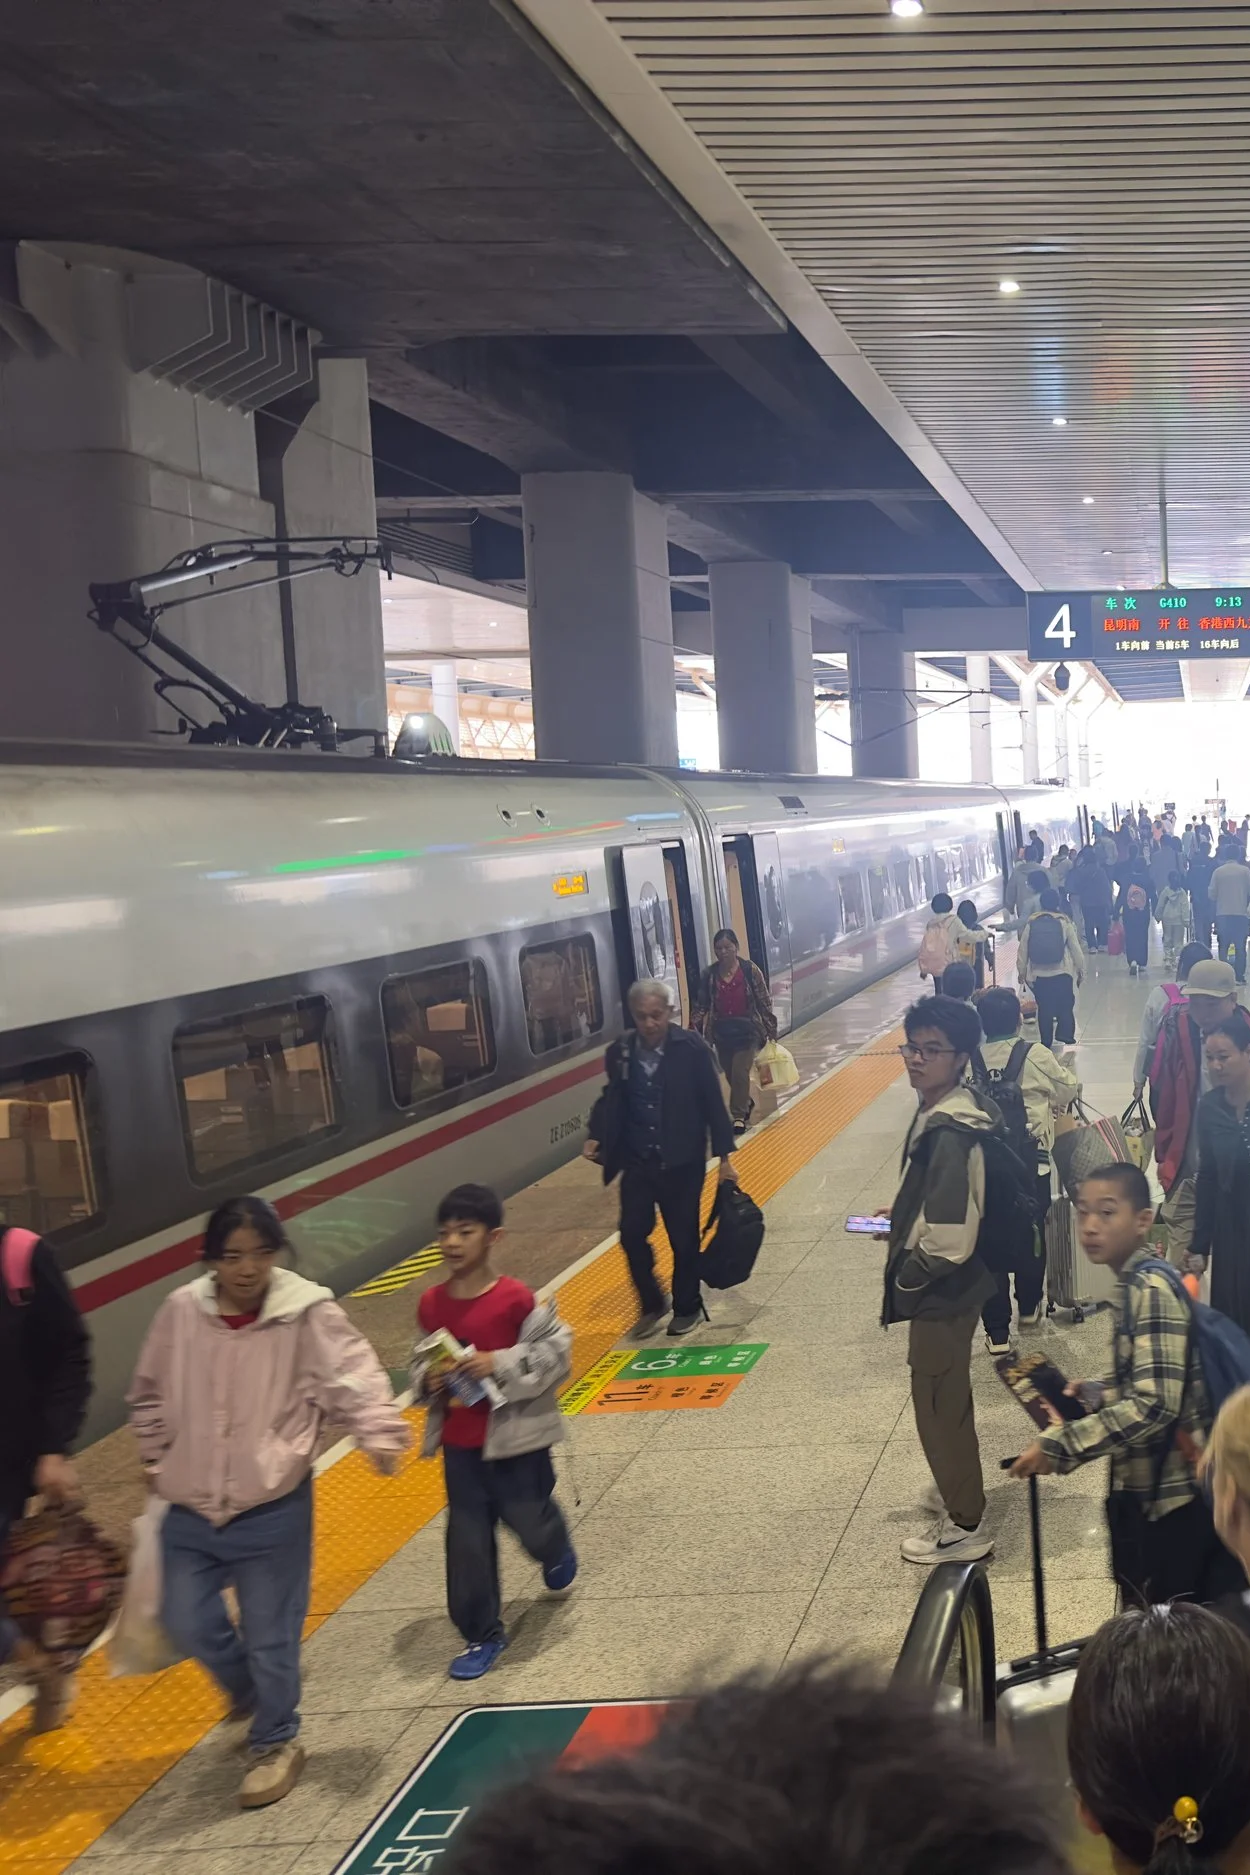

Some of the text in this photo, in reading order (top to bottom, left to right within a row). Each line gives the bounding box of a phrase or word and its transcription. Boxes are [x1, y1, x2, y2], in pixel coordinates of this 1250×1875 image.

[1159, 597, 1187, 609] G410
[1215, 596, 1242, 608] 9:13
[1044, 603, 1077, 649] 4
[1103, 618, 1141, 632] 昆明南
[1115, 638, 1240, 652] 1车向前 当前5车 16车向后
